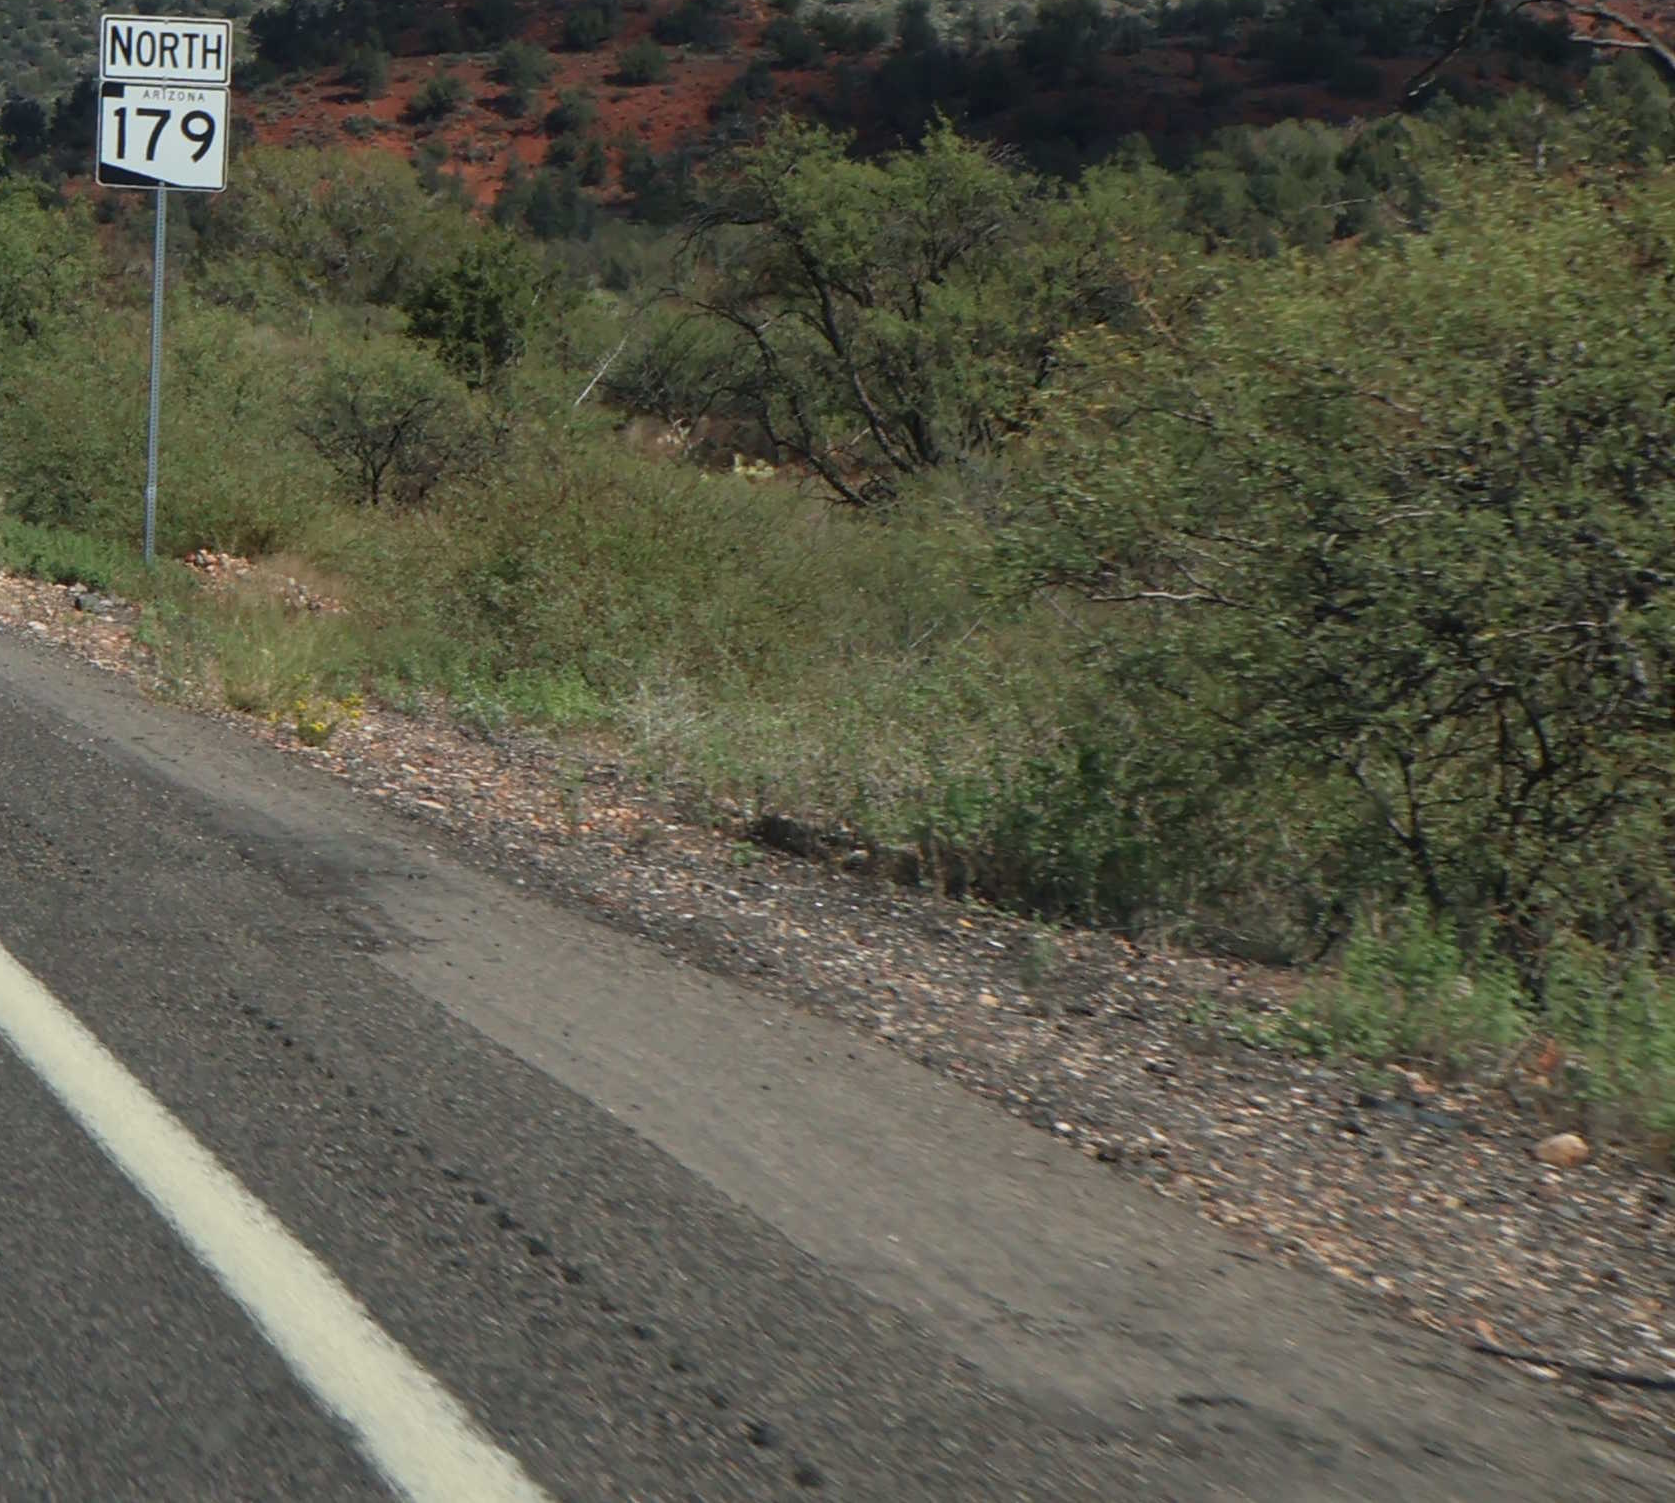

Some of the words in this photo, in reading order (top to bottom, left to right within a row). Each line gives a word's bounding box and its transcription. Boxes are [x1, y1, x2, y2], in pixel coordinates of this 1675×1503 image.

[110, 25, 222, 70] NORTH
[142, 89, 206, 102] ARIZONA
[113, 106, 216, 163] 179
